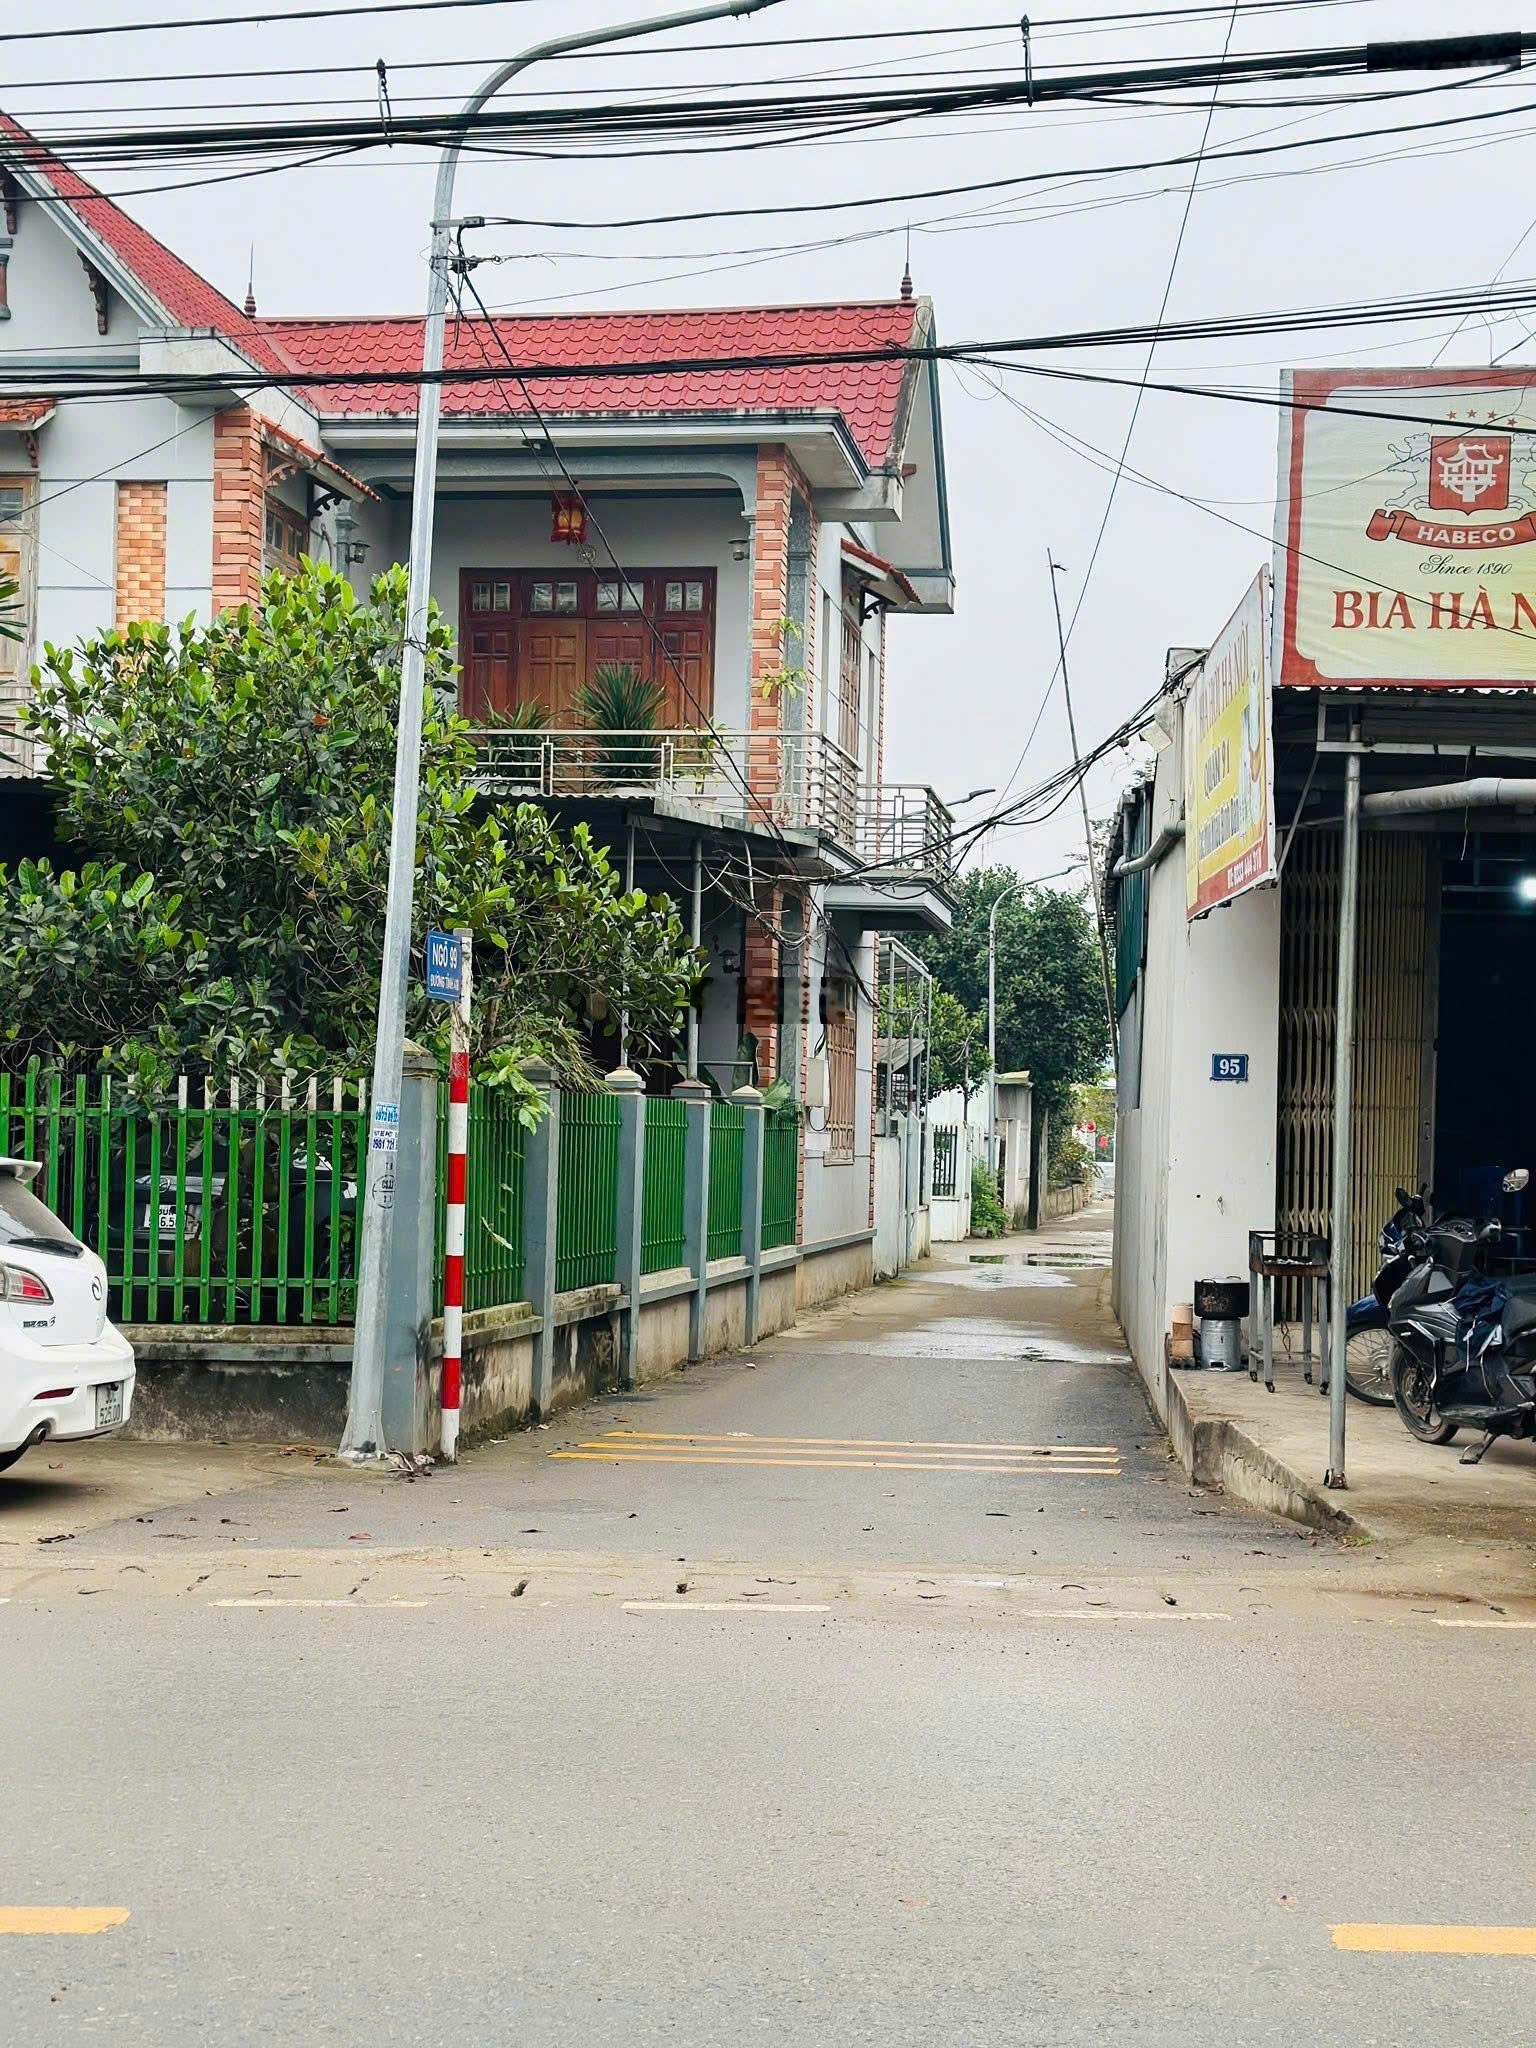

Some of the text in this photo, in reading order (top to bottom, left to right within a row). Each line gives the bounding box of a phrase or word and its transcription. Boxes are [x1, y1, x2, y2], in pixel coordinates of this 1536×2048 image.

[1417, 525, 1516, 545] HABECO
[1418, 554, 1513, 575] Since 1890
[1331, 590, 1416, 629] BIA
[1427, 584, 1499, 630] HÀ
[450, 946, 458, 969] 99
[1219, 1059, 1240, 1076] 95
